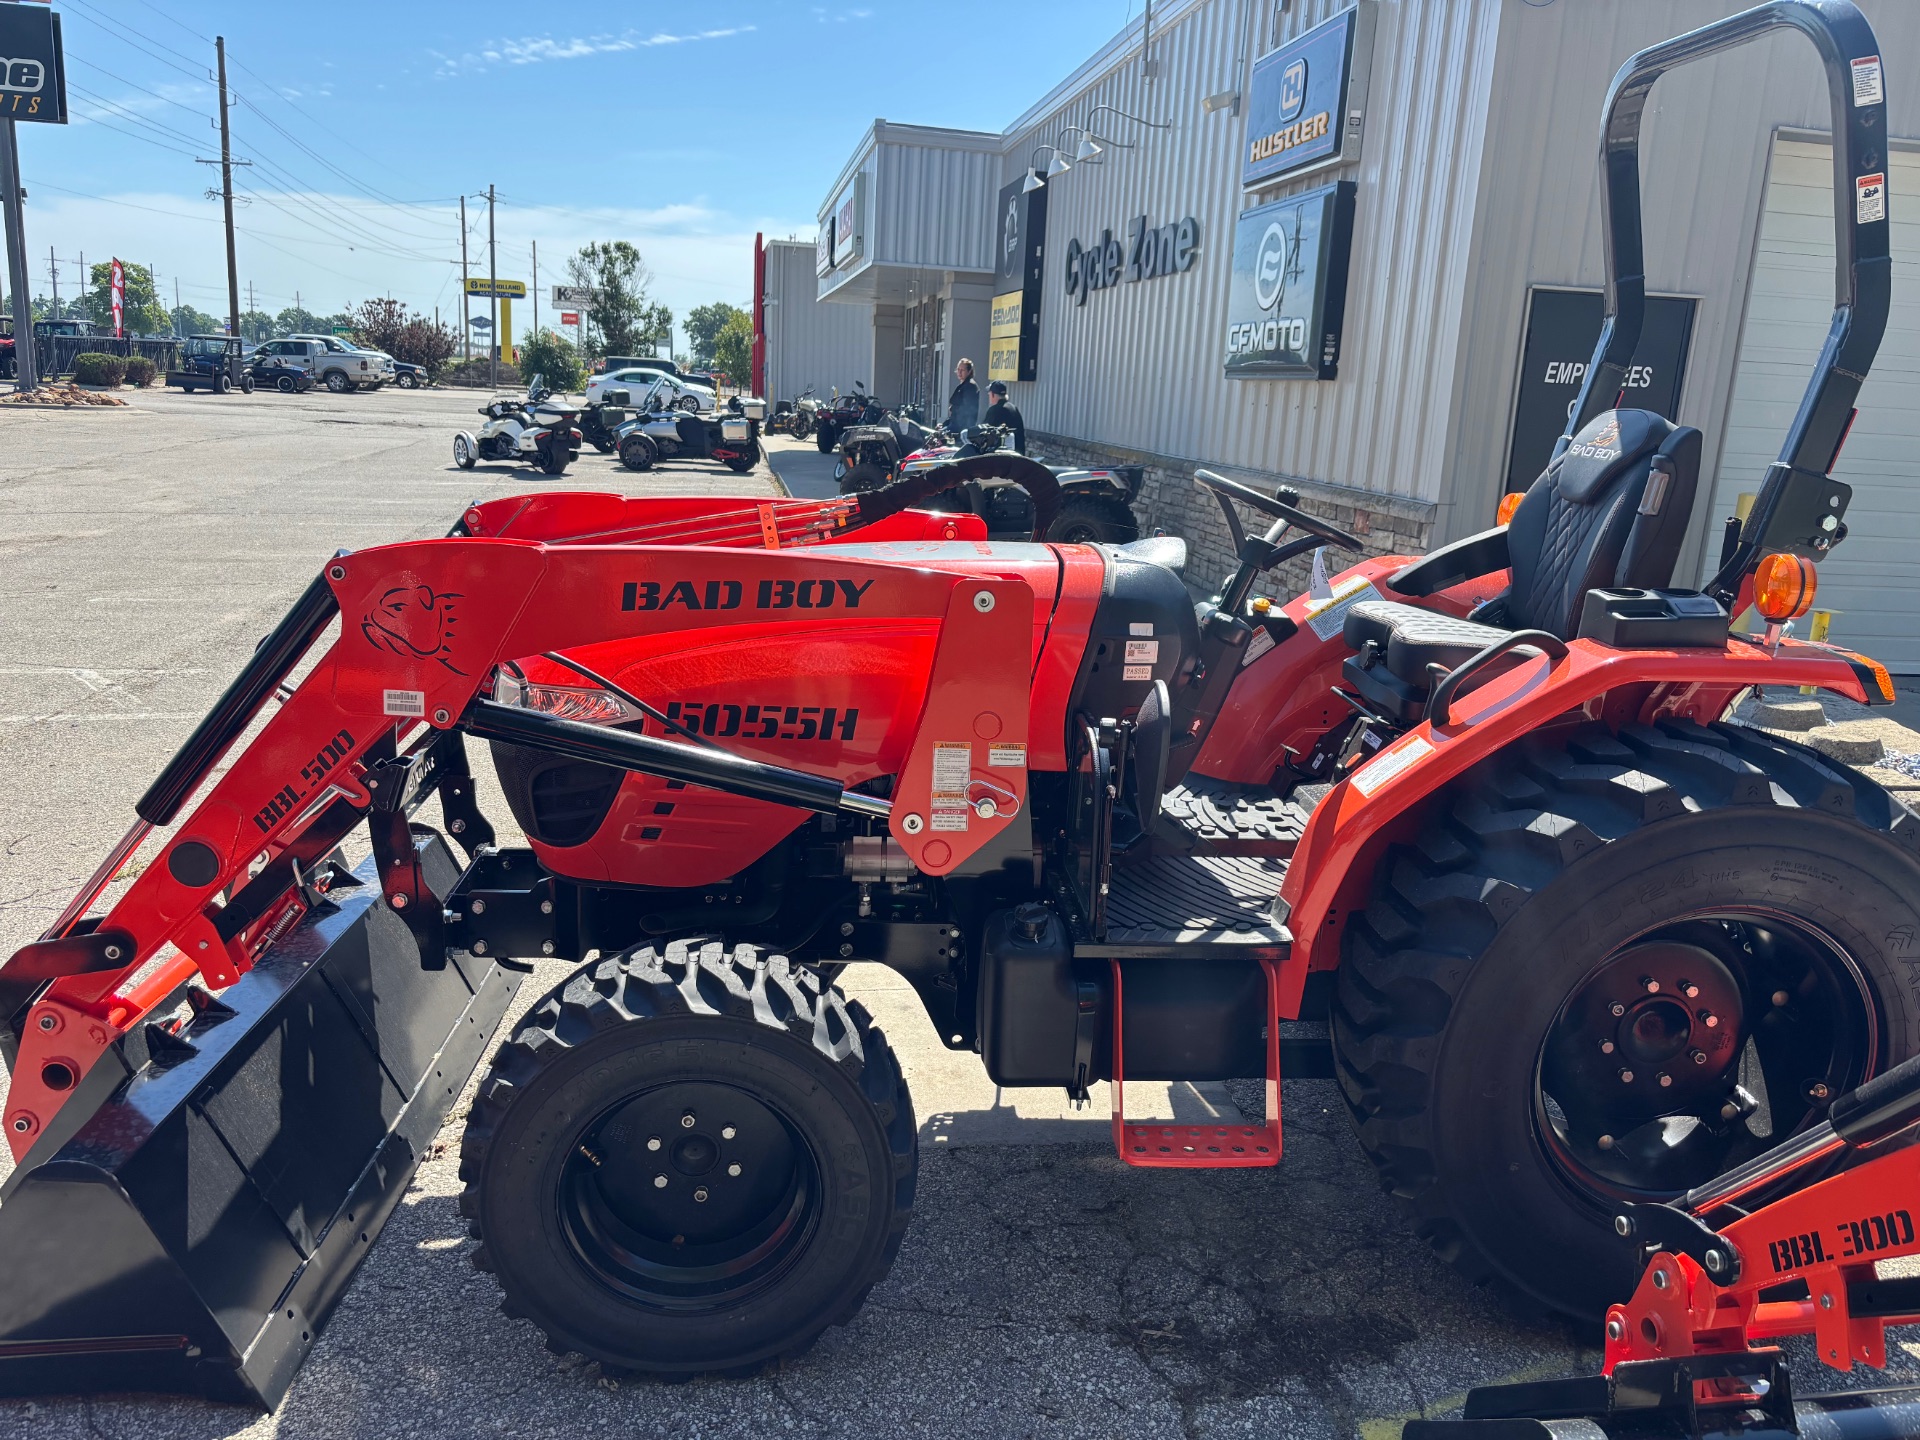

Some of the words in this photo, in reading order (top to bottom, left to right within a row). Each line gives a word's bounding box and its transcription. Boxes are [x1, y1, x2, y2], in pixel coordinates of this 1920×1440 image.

[1250, 111, 1329, 163] HUSTLER
[1065, 231, 1121, 307] Cycle
[1124, 215, 1199, 283] Zone
[1228, 317, 1305, 353] CFMOTO
[1571, 444, 1595, 457] BAD
[1594, 447, 1621, 460] BOY
[621, 580, 743, 612] BAD
[756, 579, 875, 609] BOY
[1326, 589, 1358, 609] CAUTION
[1126, 667, 1150, 675] PASSED
[664, 702, 860, 741] 5055H
[253, 784, 307, 834] BBL
[300, 729, 355, 787] 500
[1769, 1231, 1835, 1273] BBL
[1837, 1210, 1915, 1257] 300
